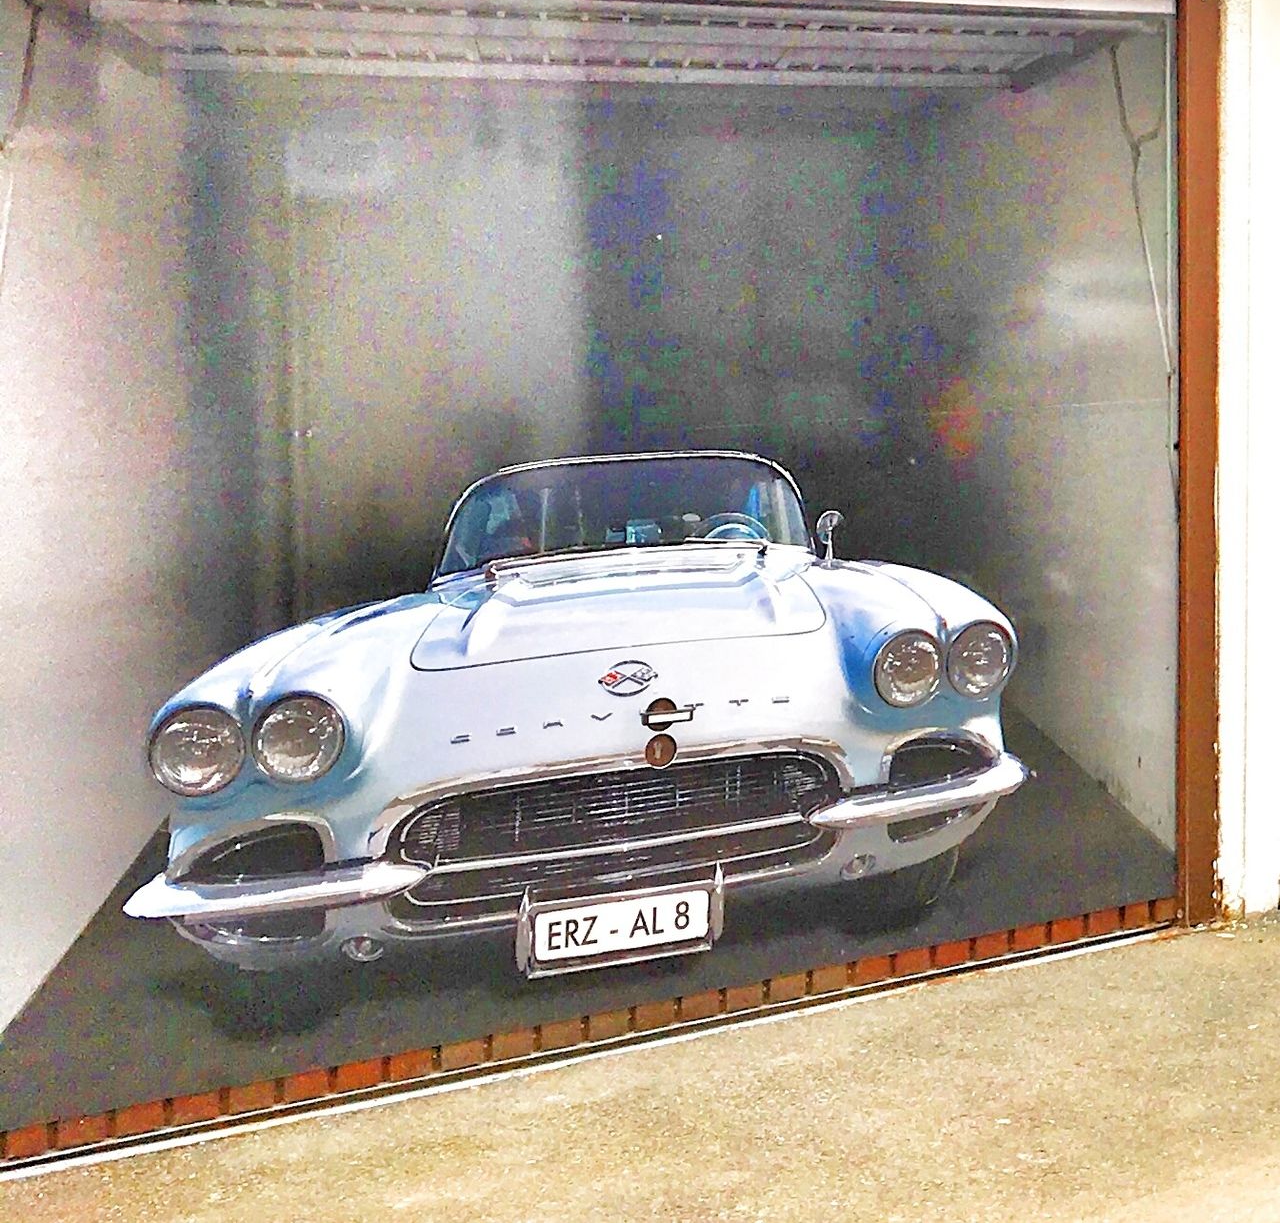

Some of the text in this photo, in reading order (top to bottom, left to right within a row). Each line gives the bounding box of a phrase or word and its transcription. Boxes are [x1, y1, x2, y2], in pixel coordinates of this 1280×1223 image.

[548, 915, 598, 951] ERZ
[629, 906, 664, 938] AL
[674, 901, 690, 930] 8
